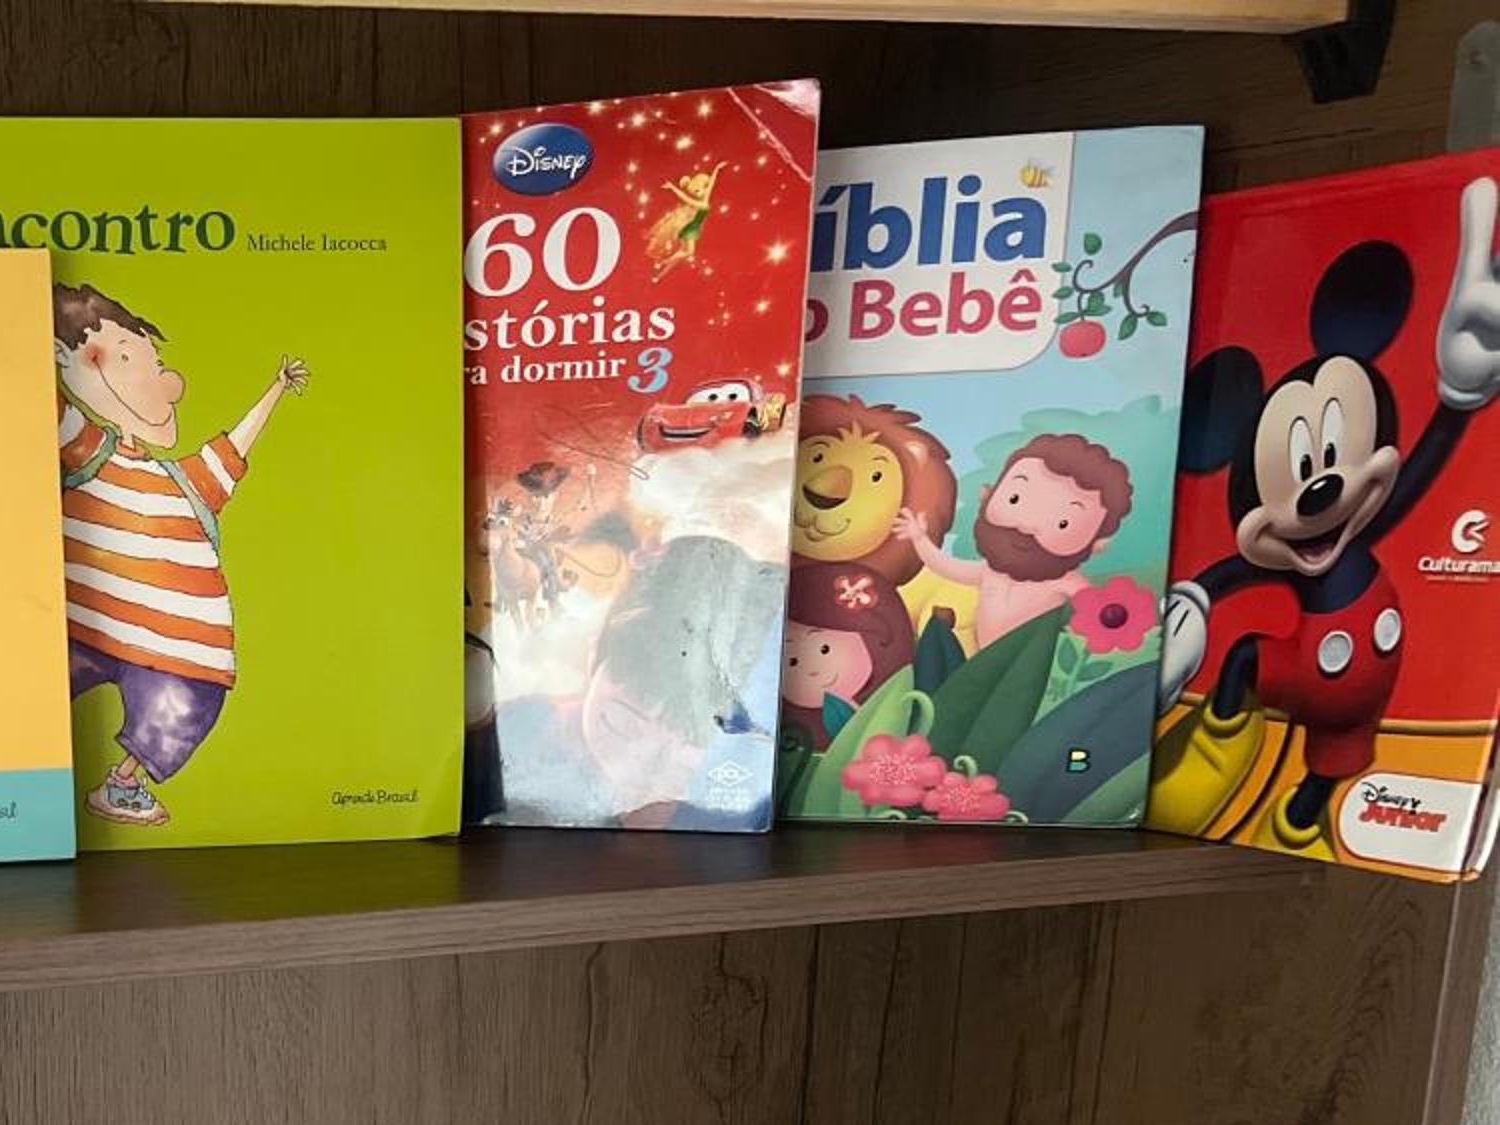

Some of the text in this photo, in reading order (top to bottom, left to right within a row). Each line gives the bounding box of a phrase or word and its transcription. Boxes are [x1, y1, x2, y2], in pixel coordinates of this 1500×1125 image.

[247, 233, 387, 251] Michele Iacocca
[464, 206, 622, 297] 60
[848, 268, 1043, 340] Bebê
[501, 350, 627, 384] dormir
[627, 347, 674, 393] 3
